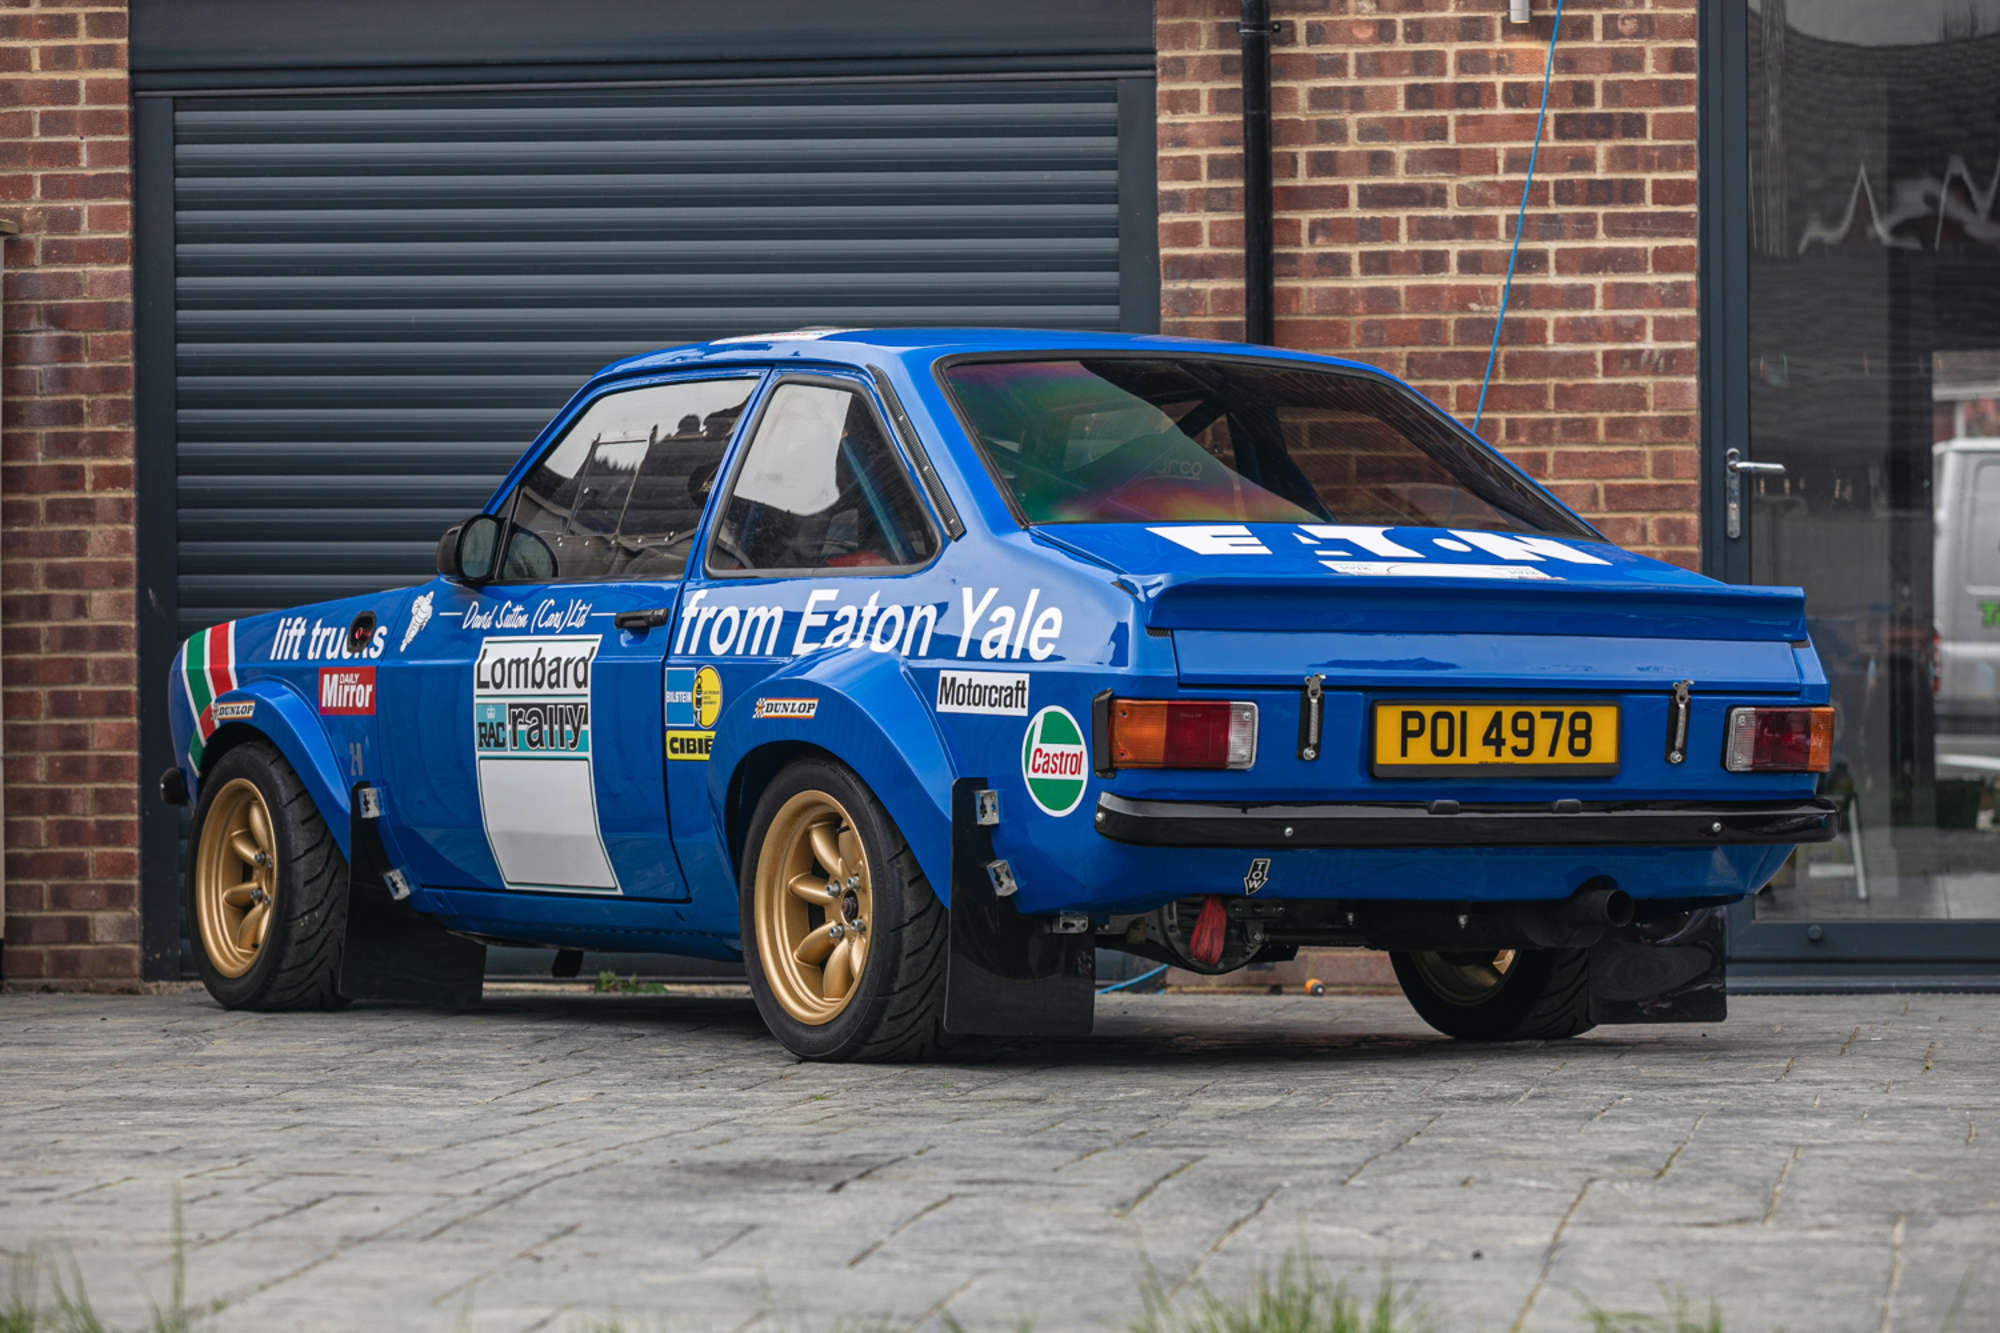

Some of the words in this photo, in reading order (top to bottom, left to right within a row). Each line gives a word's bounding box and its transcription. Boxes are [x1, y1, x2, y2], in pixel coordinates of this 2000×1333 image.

[462, 600, 498, 630] David
[495, 600, 529, 629] Sutton
[674, 588, 784, 655] from
[791, 588, 938, 657] Eaton
[955, 587, 1064, 661] Yale
[269, 616, 307, 660] lift
[306, 618, 388, 660] trus
[339, 673, 360, 684] DAILY
[476, 646, 595, 690] Lombard
[322, 674, 373, 708] Mirror
[765, 702, 816, 713] DUNLOP
[938, 676, 1027, 709] Motorcraft
[218, 705, 253, 716] DUNLOP
[478, 722, 506, 748] RAC
[509, 705, 586, 751] rally
[1400, 710, 1467, 758] POI
[1482, 710, 1592, 758] 4978
[1031, 747, 1083, 775] Castrol
[1248, 861, 1266, 889] TOW
